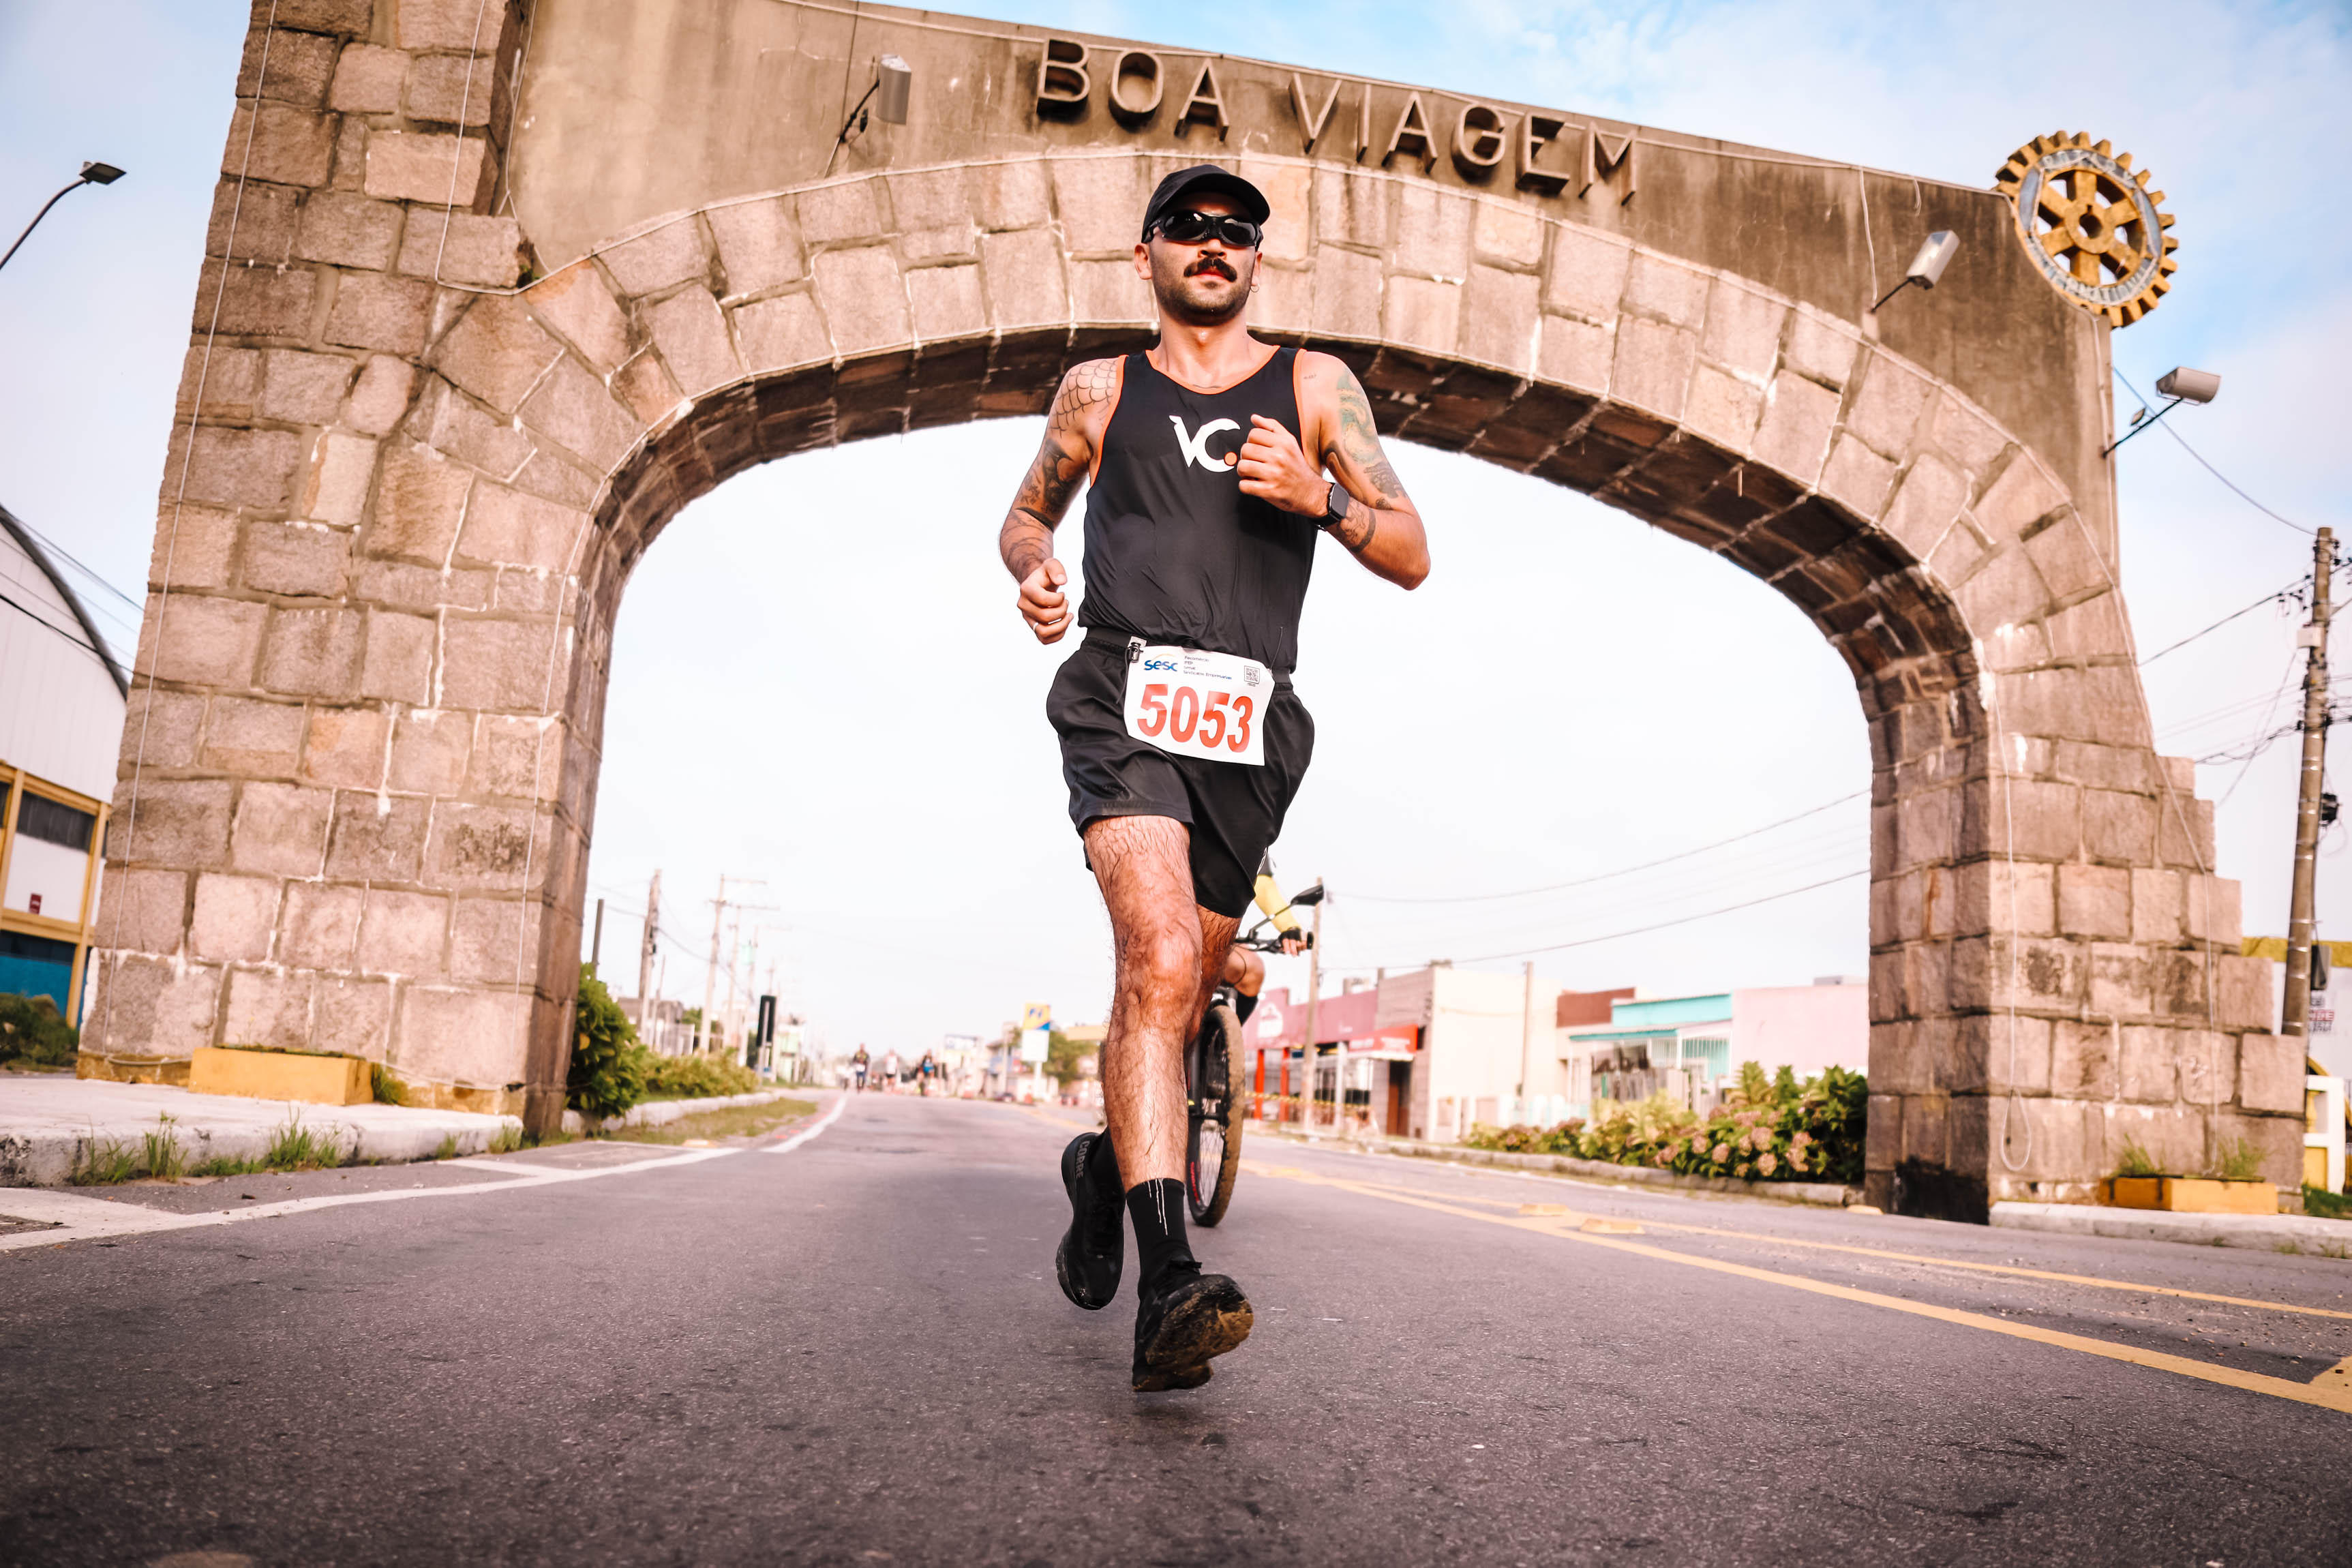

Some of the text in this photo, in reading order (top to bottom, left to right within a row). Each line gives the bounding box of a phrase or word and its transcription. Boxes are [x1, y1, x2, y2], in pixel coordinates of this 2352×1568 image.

[1037, 39, 1637, 206] BOA VIAGEM
[1136, 683, 1254, 753] 5053
